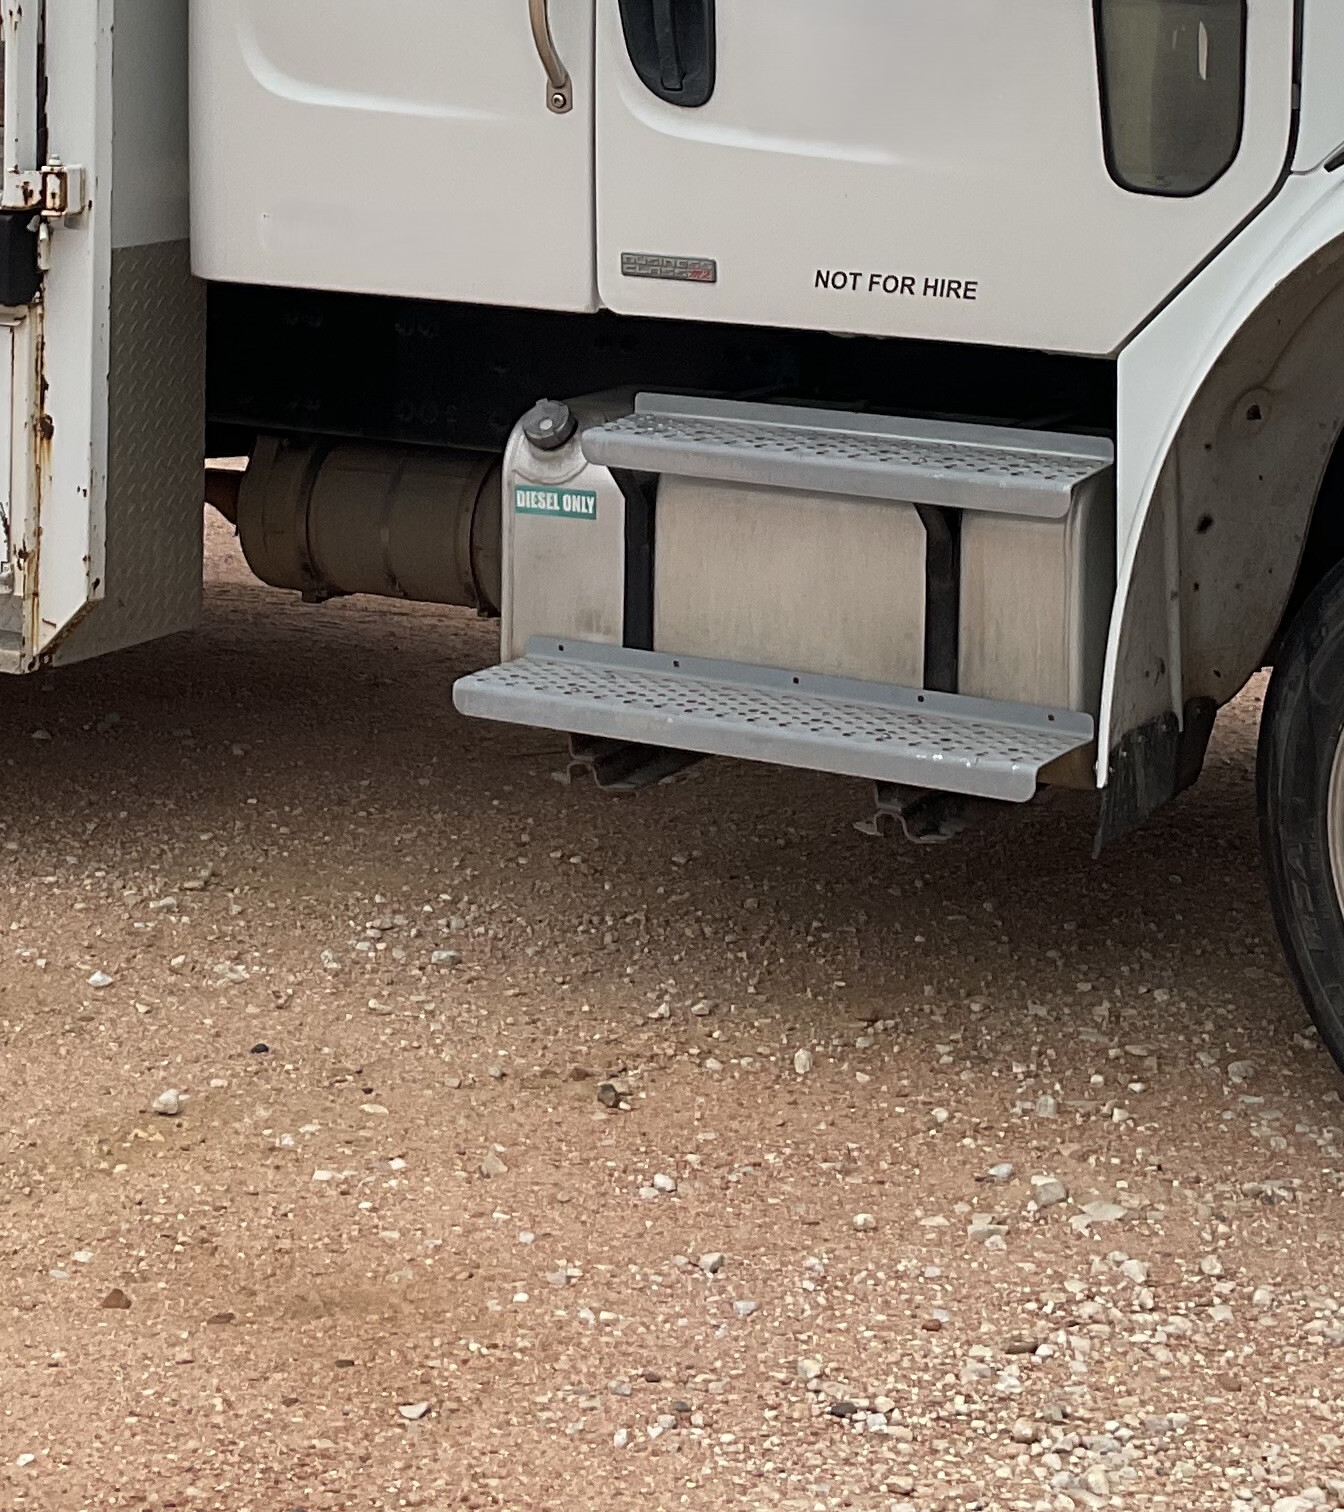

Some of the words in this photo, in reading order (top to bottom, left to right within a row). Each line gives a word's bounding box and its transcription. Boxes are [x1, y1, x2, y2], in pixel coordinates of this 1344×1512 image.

[814, 269, 863, 291] NOT
[868, 273, 916, 296] FOR
[922, 277, 979, 300] HIRE
[516, 489, 560, 511] DIESEL
[562, 494, 595, 514] ONLY
